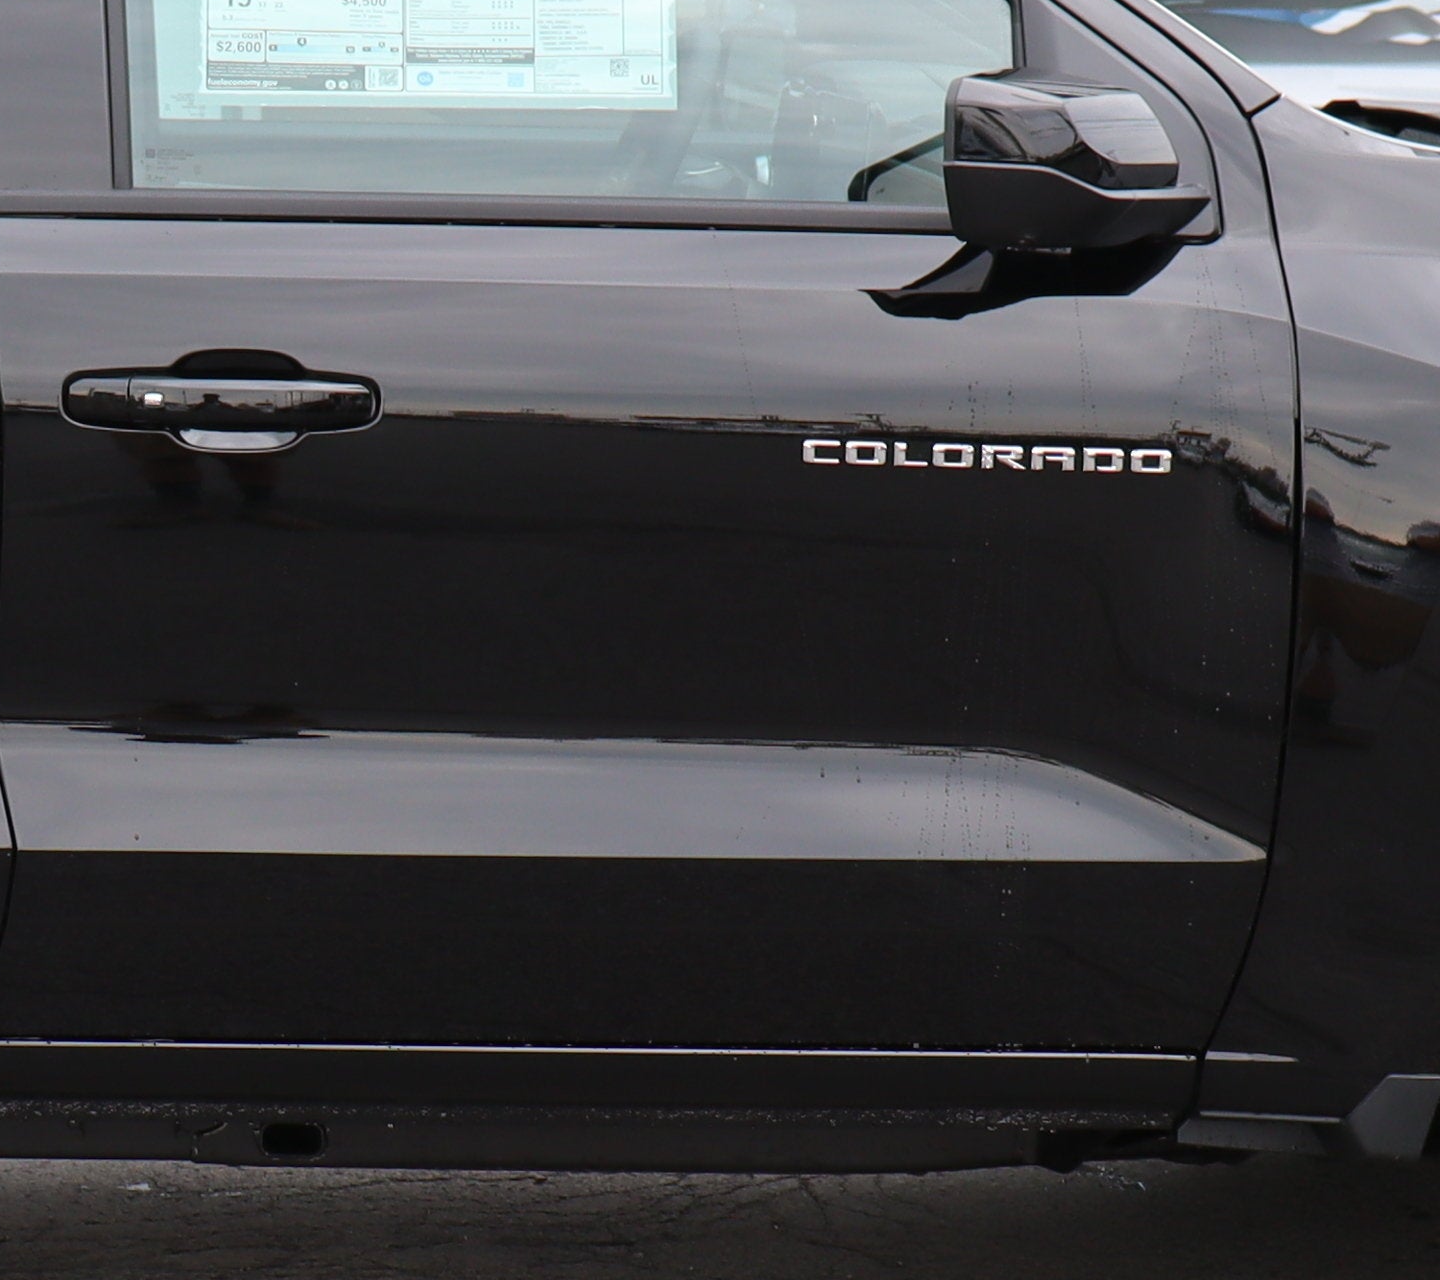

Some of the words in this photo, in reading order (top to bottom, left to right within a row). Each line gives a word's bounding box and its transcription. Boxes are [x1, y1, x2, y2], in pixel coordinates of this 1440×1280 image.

[241, 32, 264, 40] cost
[216, 40, 262, 55] $2,600
[802, 438, 1173, 475] COLORADO
